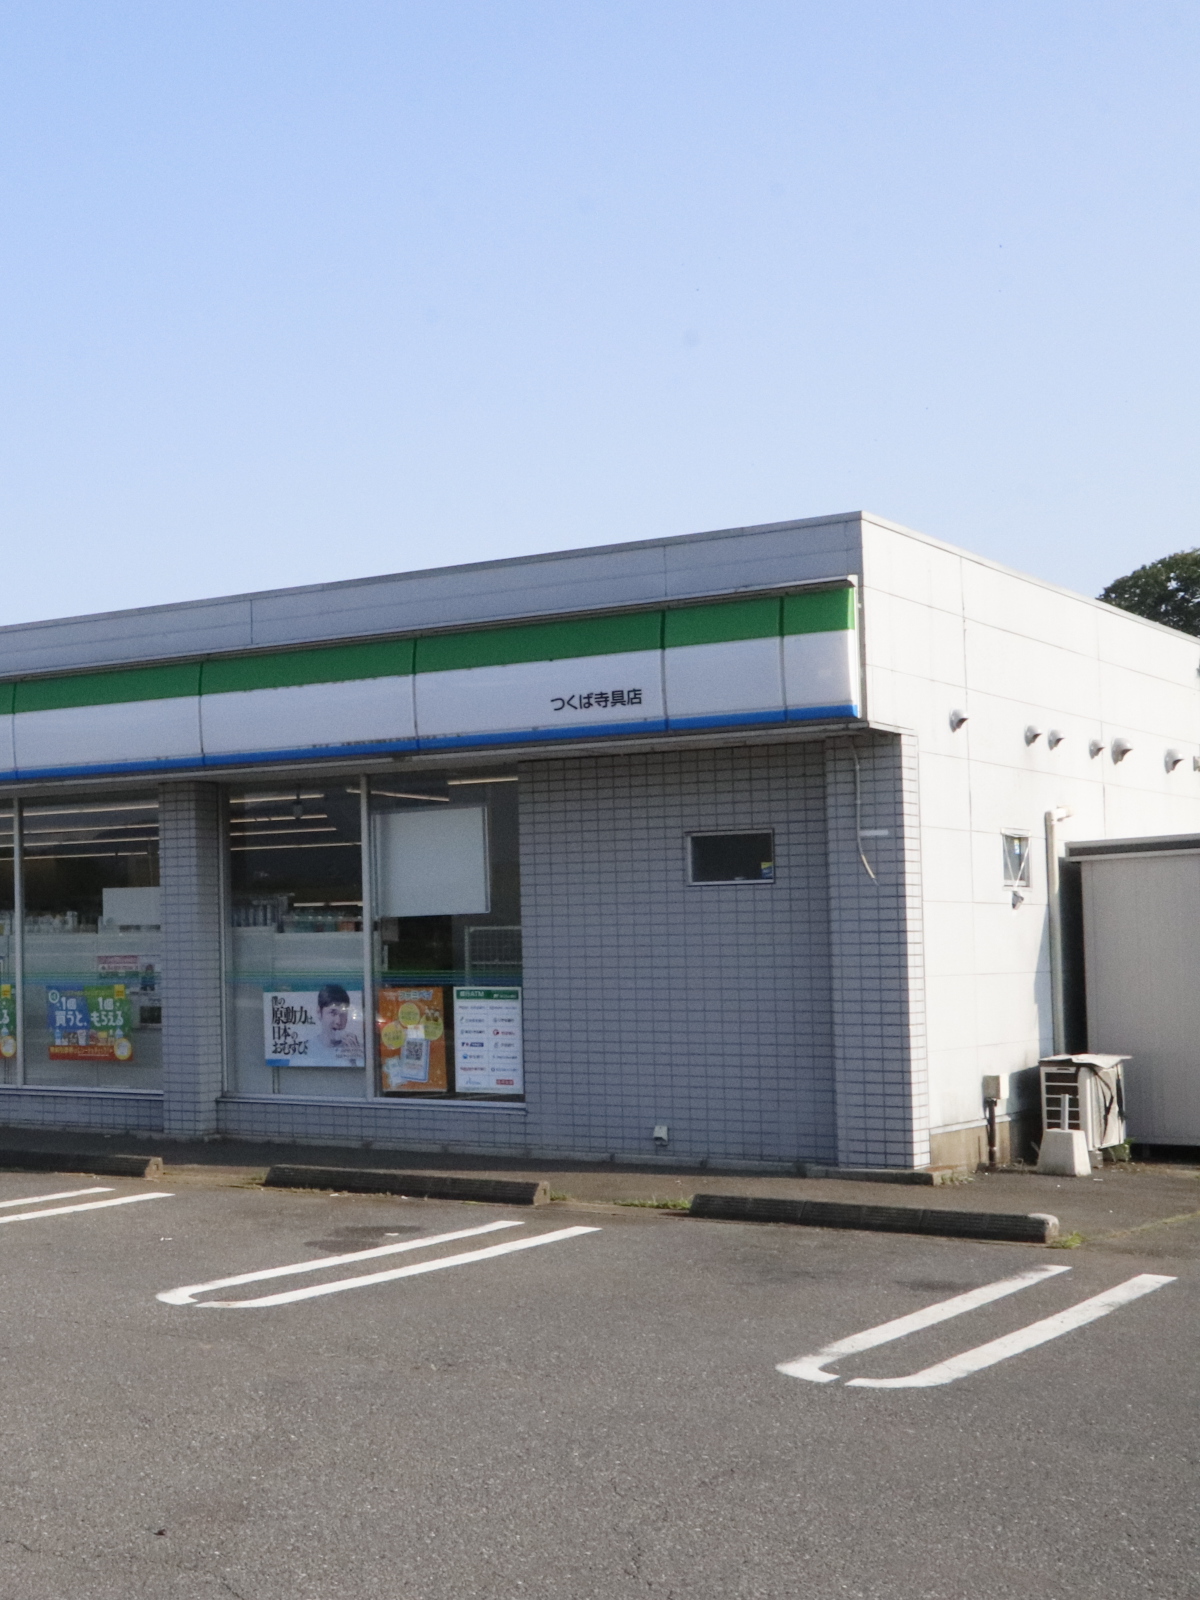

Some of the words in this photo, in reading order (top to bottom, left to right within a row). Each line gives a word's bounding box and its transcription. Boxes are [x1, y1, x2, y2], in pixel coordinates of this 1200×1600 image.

[550, 689, 642, 711] つくば寺具店
[273, 1025, 299, 1041] 日本の
[272, 1040, 309, 1056] おむすび
